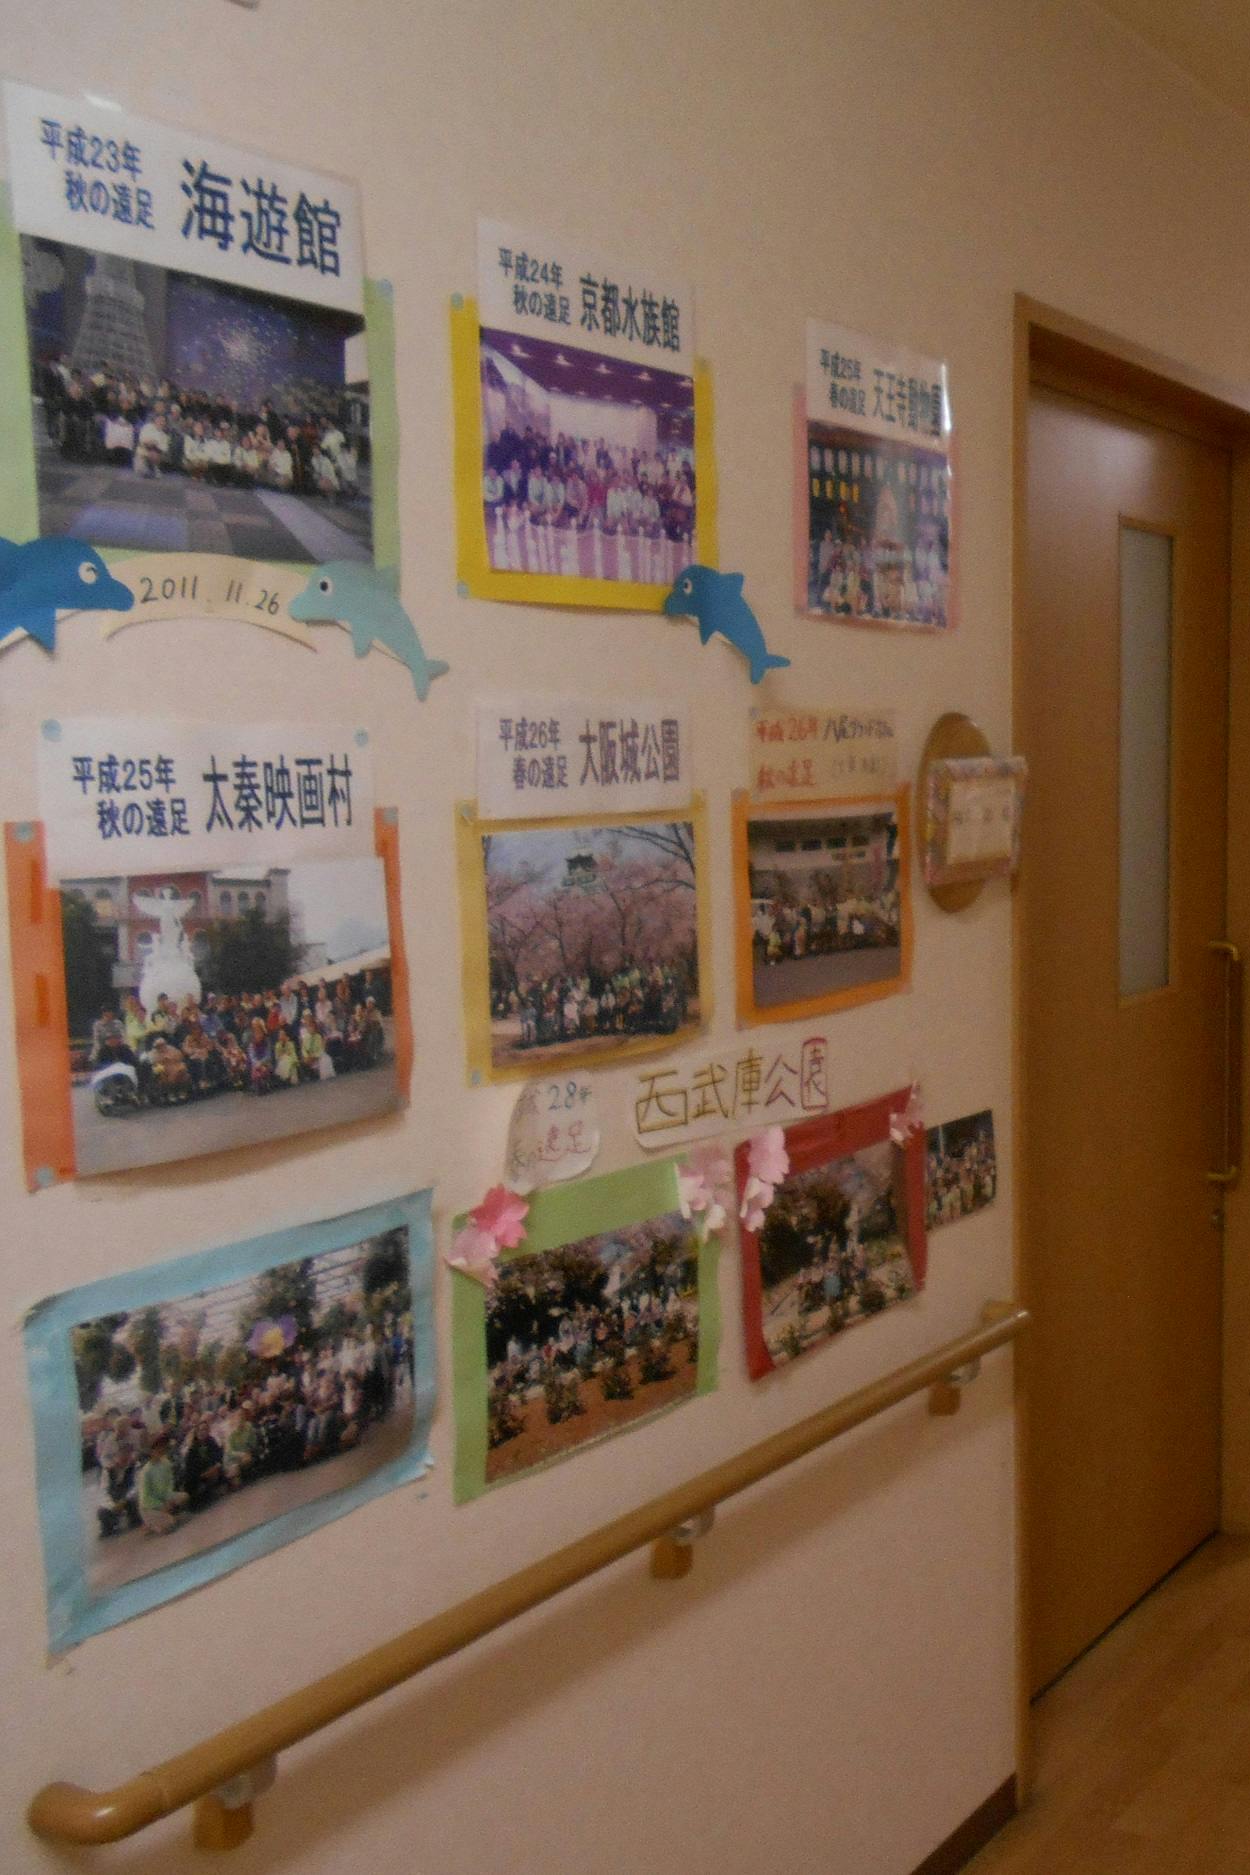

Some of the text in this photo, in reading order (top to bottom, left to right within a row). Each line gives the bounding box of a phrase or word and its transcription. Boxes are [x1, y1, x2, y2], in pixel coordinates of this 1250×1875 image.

[40, 117, 143, 182] 平成23年
[64, 168, 155, 231] 秋の遠足
[180, 158, 341, 279] 海遊館
[498, 247, 564, 289] 平成24年
[512, 284, 572, 326] 秋の遠足
[579, 272, 682, 353] 京都水族館
[498, 716, 561, 752] 平成26年
[577, 716, 680, 787] 大阪城公園
[72, 754, 177, 795] 平成25年
[203, 753, 353, 833] 太秦映画村
[512, 754, 569, 790] 春の遠足
[97, 798, 191, 840] 秋の遠足
[634, 1036, 829, 1135] 西武庫公園
